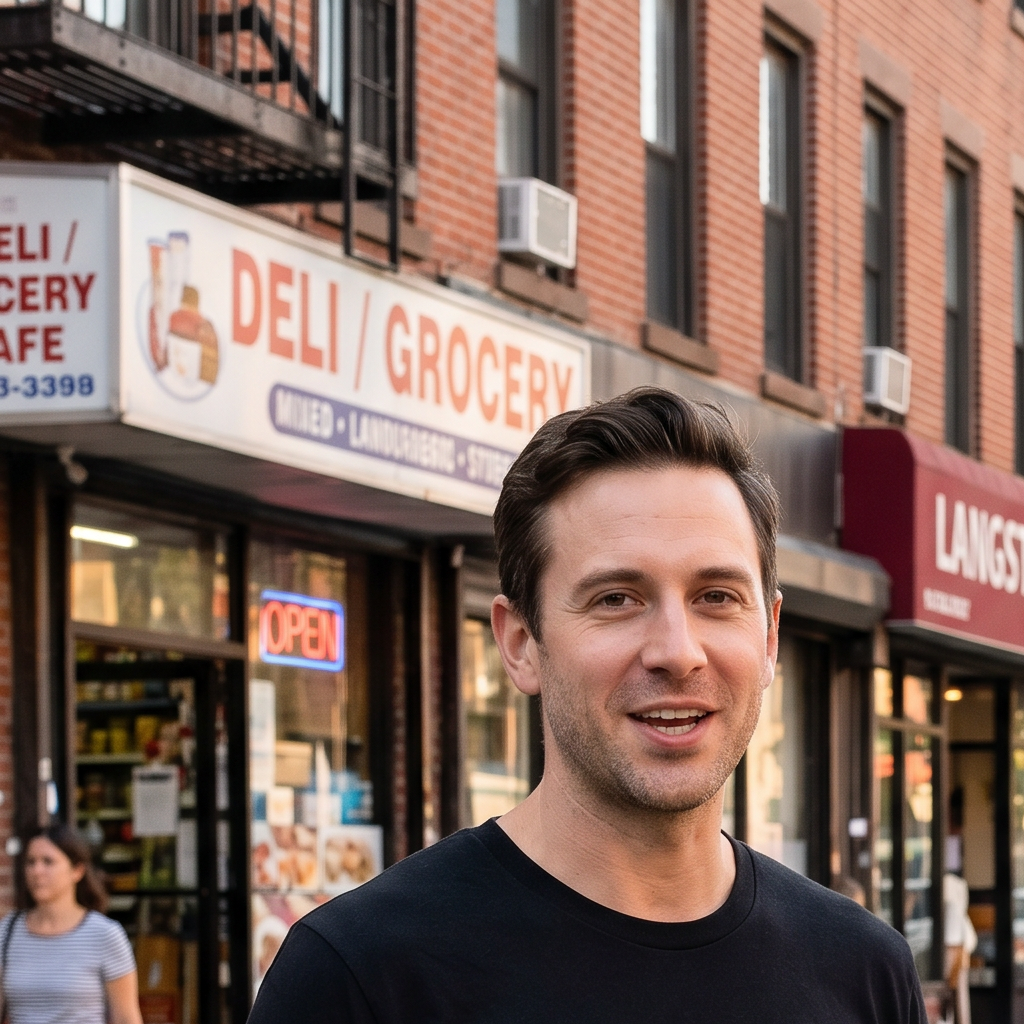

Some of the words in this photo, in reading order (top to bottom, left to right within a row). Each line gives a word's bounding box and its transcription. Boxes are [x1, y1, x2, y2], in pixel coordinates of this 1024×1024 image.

[231, 247, 340, 376] DELI
[385, 304, 574, 434] GROCERY
[260, 600, 341, 662] OPEN
